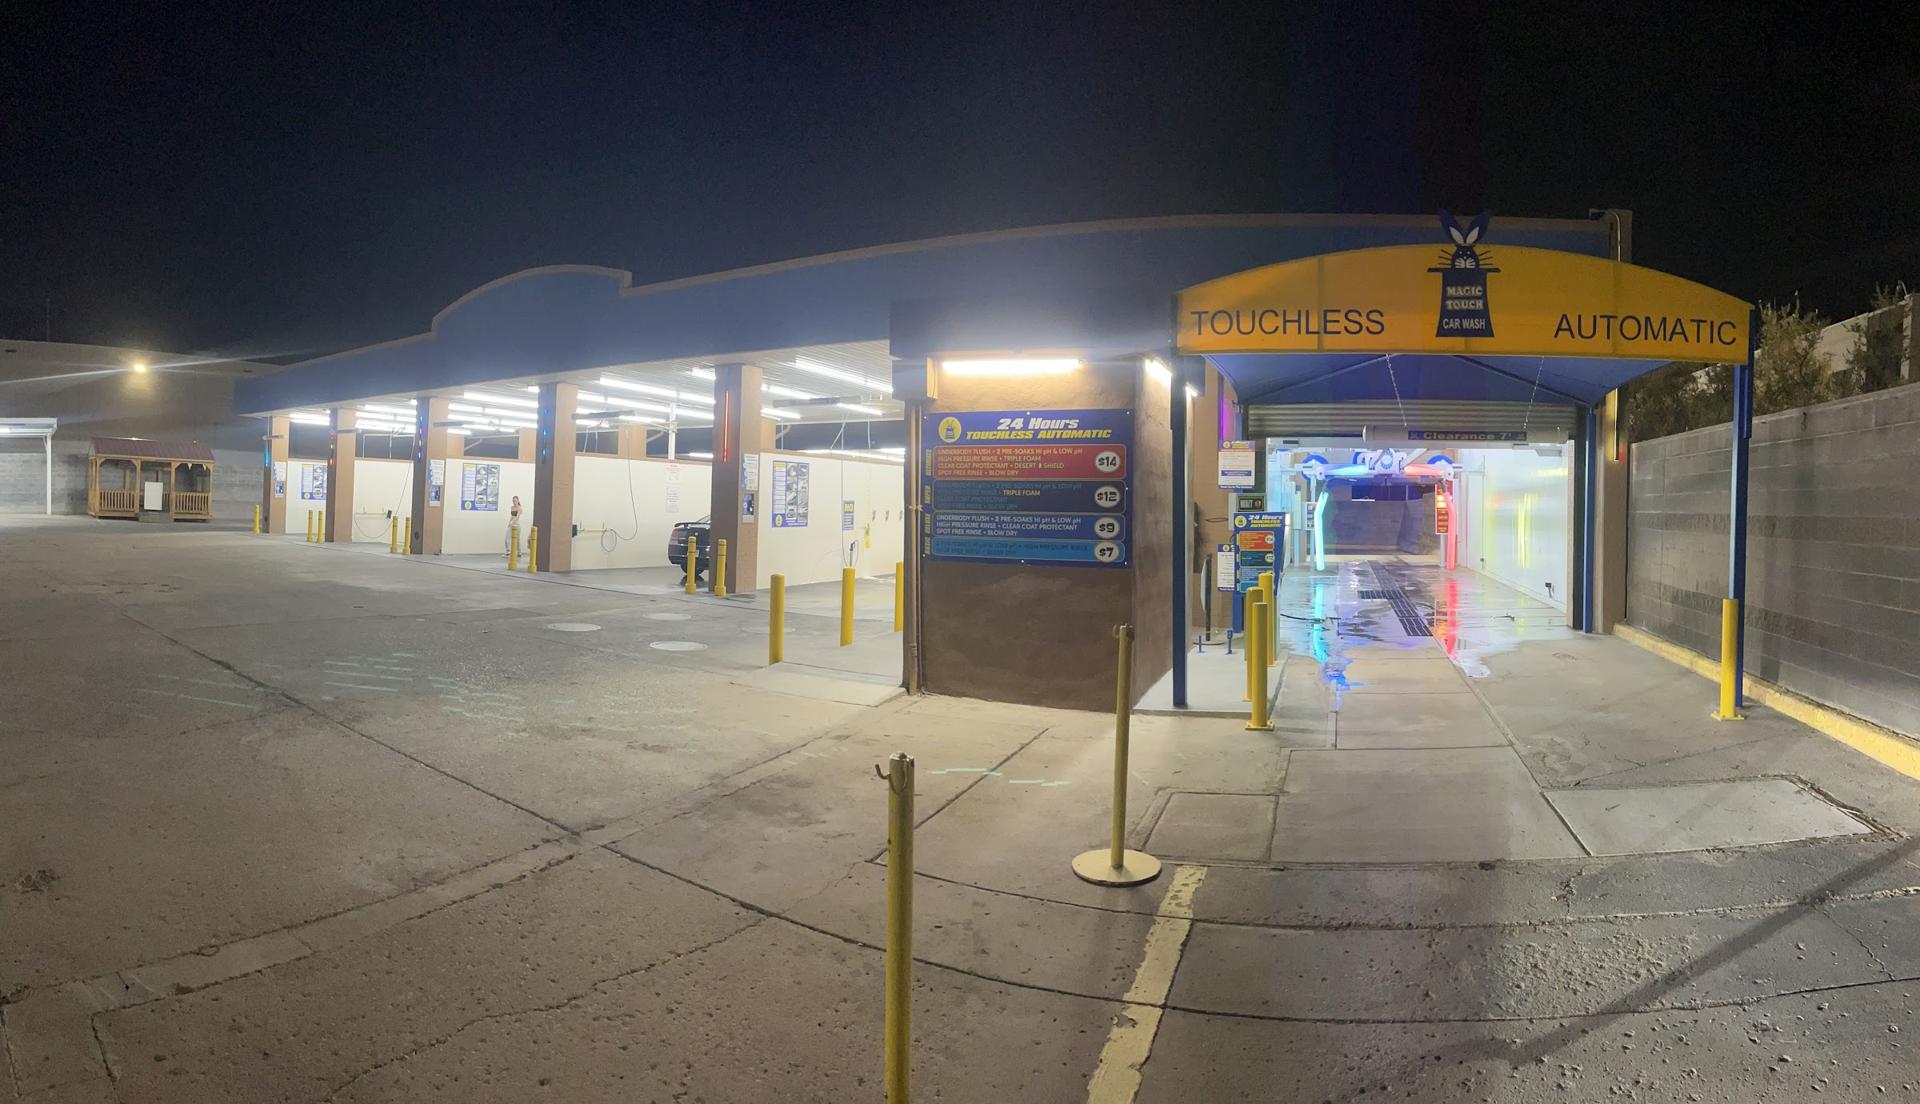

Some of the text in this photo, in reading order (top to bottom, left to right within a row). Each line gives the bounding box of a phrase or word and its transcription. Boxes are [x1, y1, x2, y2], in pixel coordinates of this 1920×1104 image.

[1446, 286, 1483, 296] MAGIC
[1446, 299, 1484, 310] TOUCH
[1190, 309, 1384, 336] TOUCHLESS
[1442, 318, 1486, 329] CAR WASH
[1554, 314, 1736, 346] AUTOMATIC
[997, 418, 1080, 430] 24 Hours
[966, 429, 1112, 440] TOUCHLESS AUTOMATIC
[1424, 432, 1495, 440] Clearance
[1098, 456, 1116, 467] $14
[1097, 492, 1117, 502] $12
[1099, 522, 1115, 533] $9
[1099, 547, 1114, 558] $7
